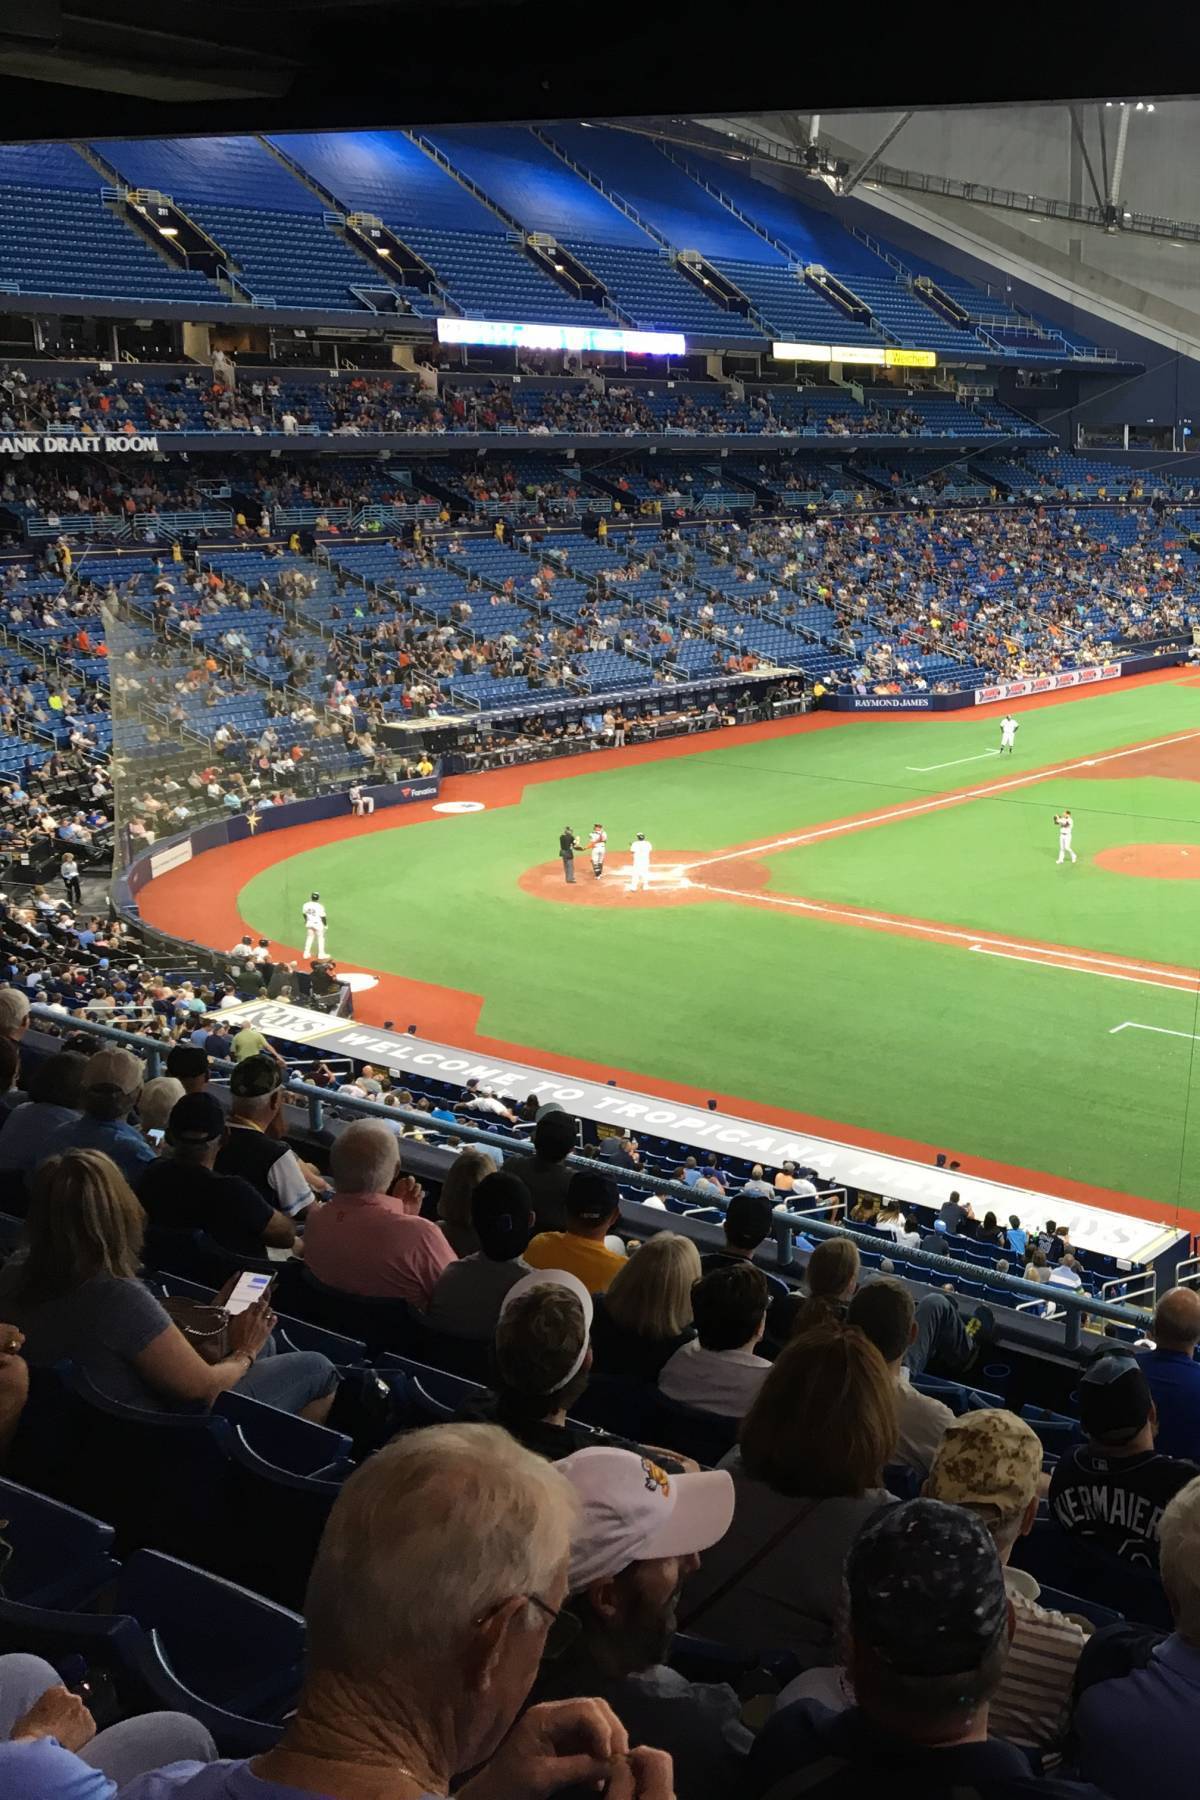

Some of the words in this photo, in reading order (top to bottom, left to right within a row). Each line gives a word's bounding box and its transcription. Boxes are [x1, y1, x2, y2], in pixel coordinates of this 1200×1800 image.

[892, 351, 929, 364] Weichert
[43, 437, 100, 453] DRAFT
[105, 436, 159, 452] ROOM
[855, 699, 899, 708] RAYMOND
[899, 698, 929, 707] JAMES
[238, 1004, 325, 1035] RAYS
[338, 1032, 527, 1085] WELCOME
[530, 1080, 585, 1100] TO
[592, 1096, 840, 1168] TROPICANA
